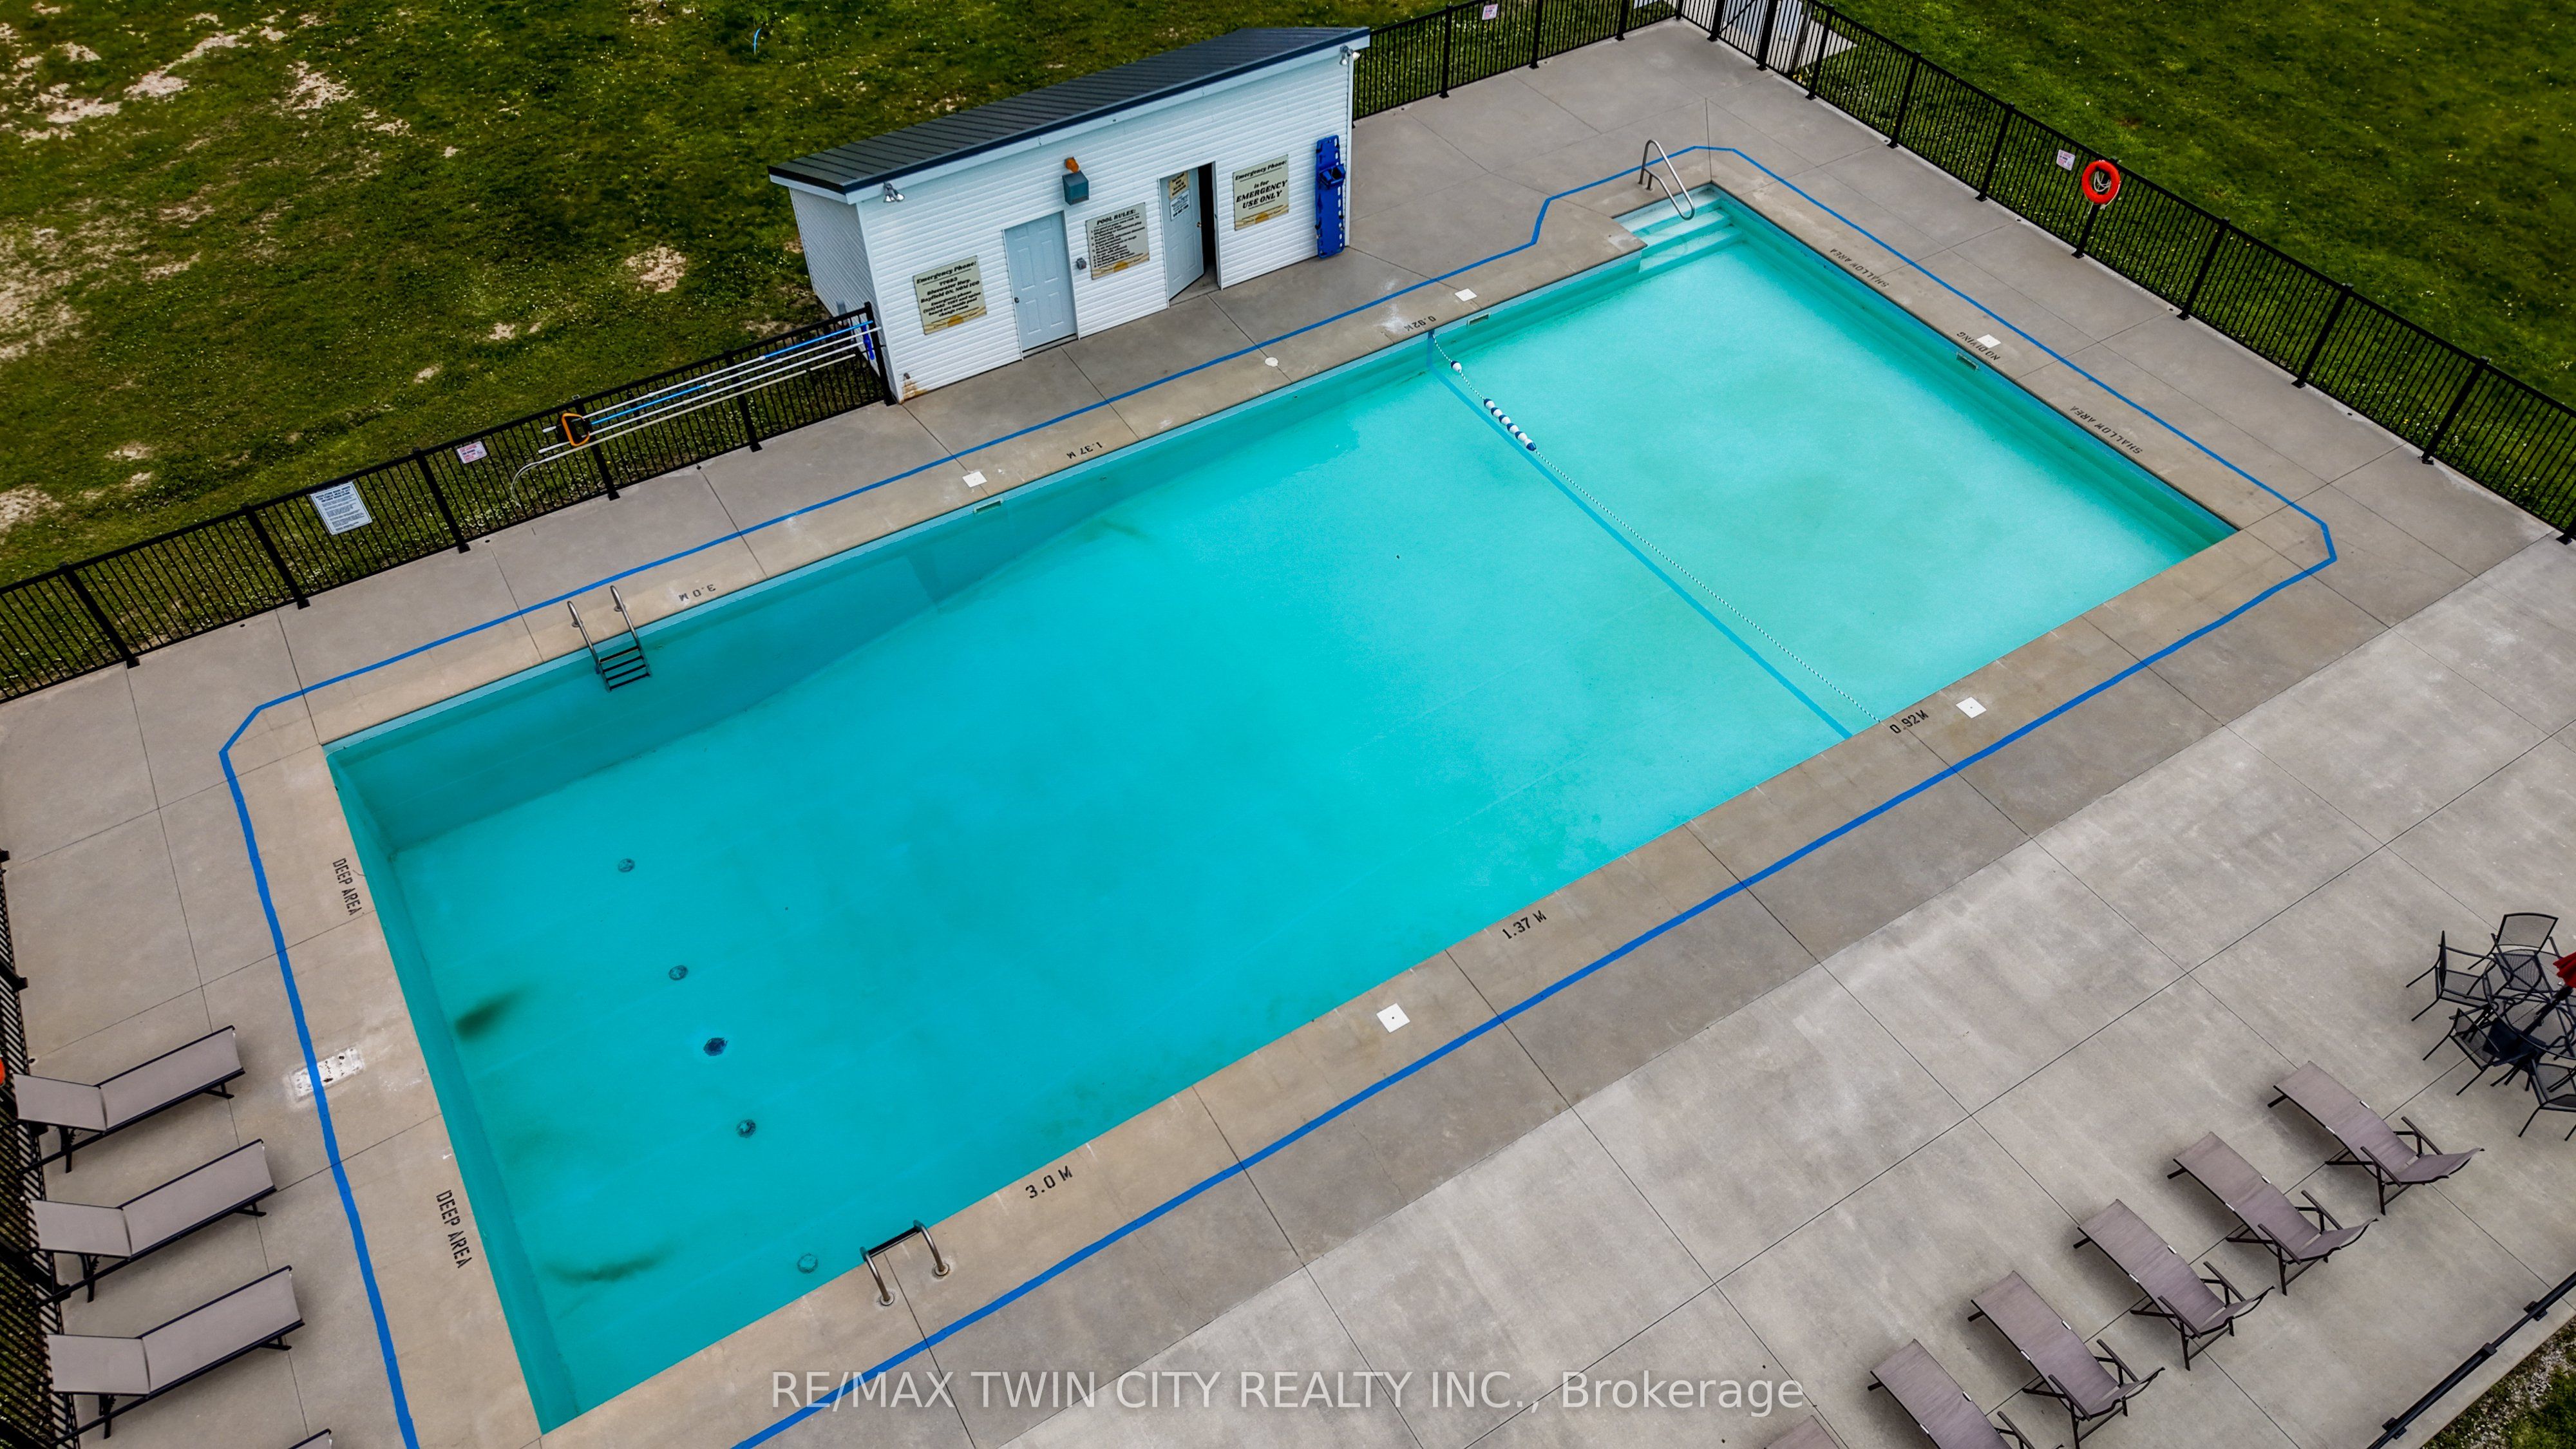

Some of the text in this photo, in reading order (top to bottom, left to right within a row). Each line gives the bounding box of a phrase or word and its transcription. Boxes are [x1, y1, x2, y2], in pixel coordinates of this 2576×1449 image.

[1235, 160, 1287, 181] Emergency Phone:
[1236, 180, 1288, 203] EMERGENCY
[1242, 190, 1282, 209] USE ONLY
[1097, 209, 1136, 225] POOL RULES:
[916, 269, 953, 284] Emergency
[1830, 248, 1889, 287] SHALLOW AREA
[2070, 406, 2143, 454] SHALLOW AREA
[1080, 442, 1103, 455] 1.37
[679, 584, 716, 601] 3.0 M
[332, 858, 362, 915] DEEP AREA
[1502, 910, 1547, 939] 1.37 M
[1025, 1165, 1073, 1198] 3.0 M
[436, 1189, 472, 1269] DEEP AREA
